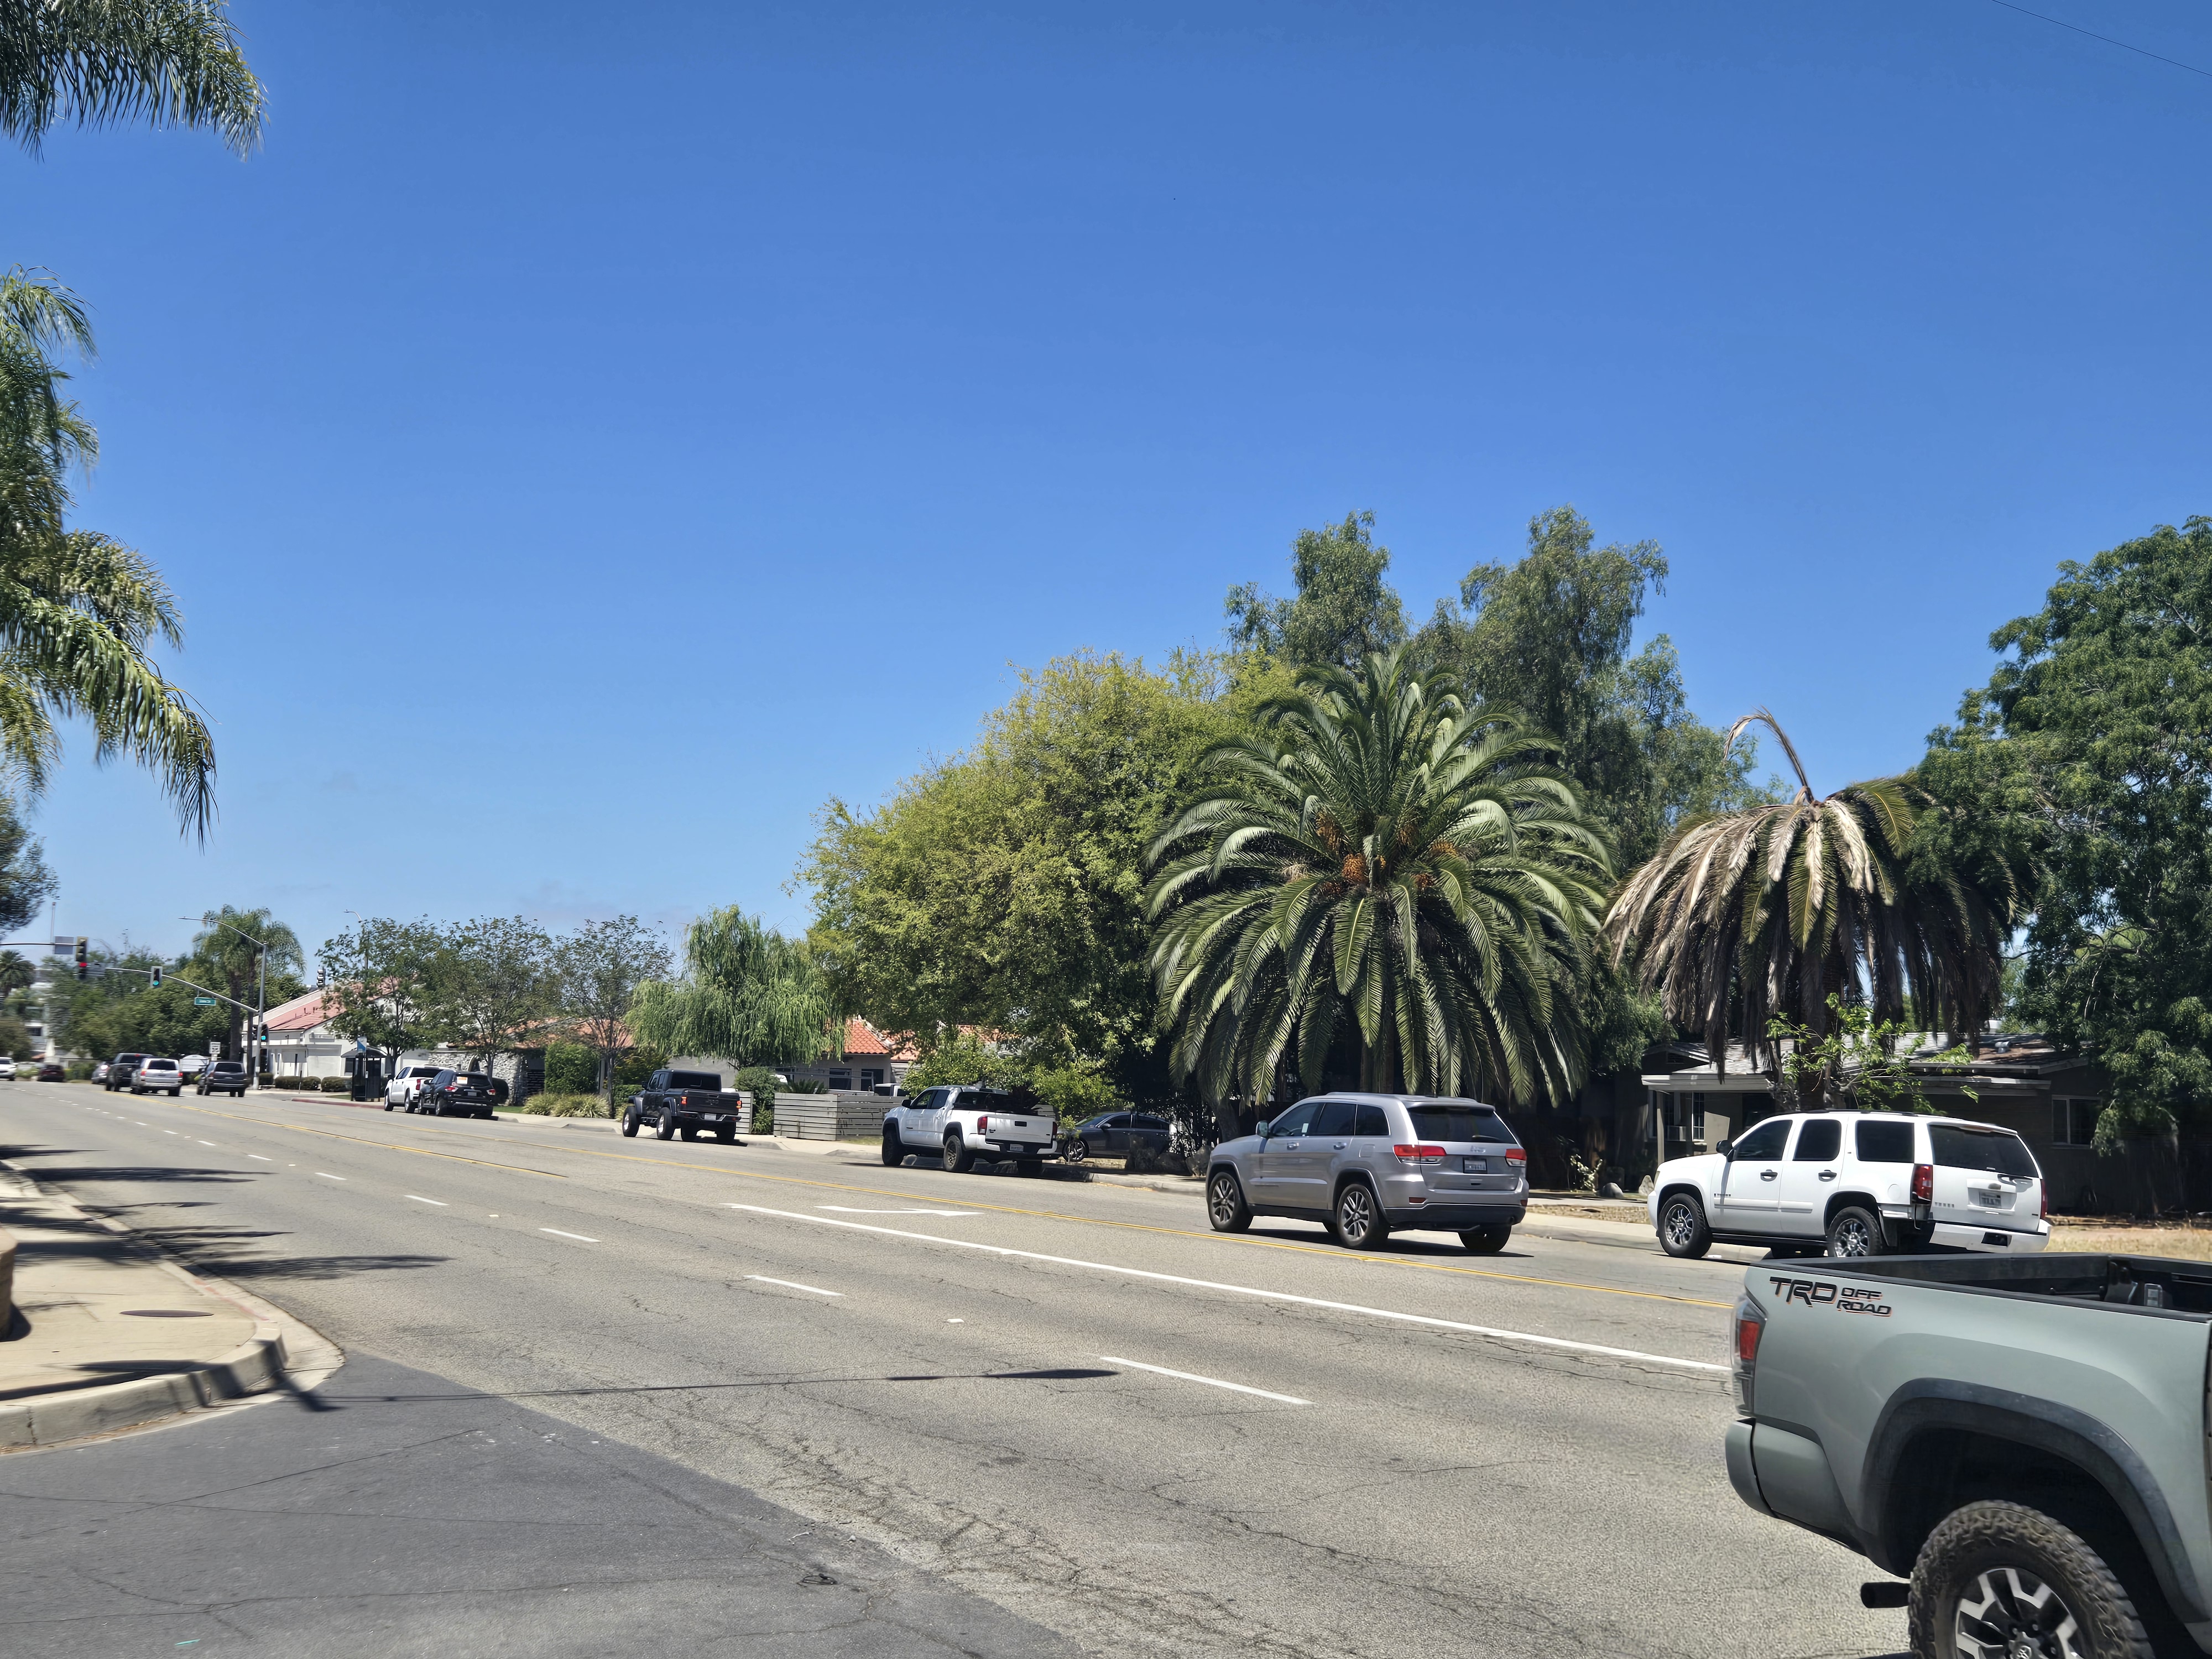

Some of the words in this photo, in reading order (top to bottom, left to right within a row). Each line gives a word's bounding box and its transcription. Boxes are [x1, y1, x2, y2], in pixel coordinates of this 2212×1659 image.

[1770, 1276, 1837, 1307] TRD
[1840, 1287, 1882, 1301] OFF
[1837, 1300, 1892, 1317] ROAD
